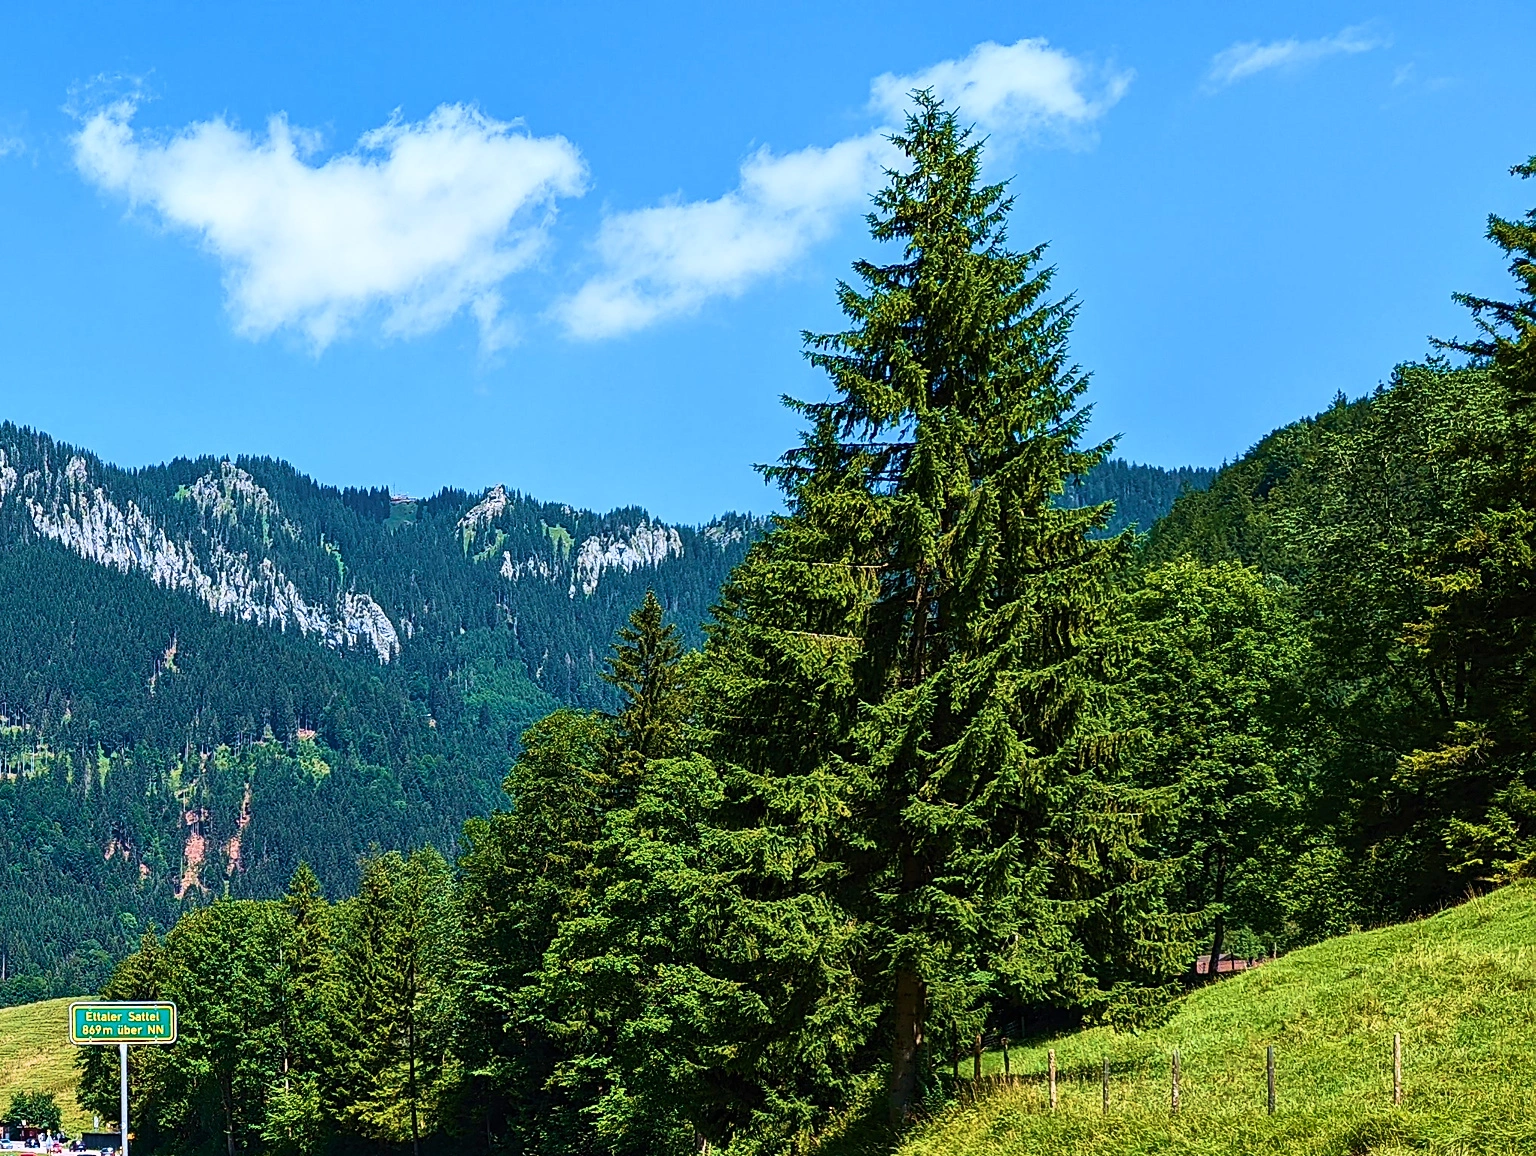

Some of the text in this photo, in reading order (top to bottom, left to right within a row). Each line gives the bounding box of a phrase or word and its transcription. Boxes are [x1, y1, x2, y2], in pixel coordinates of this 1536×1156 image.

[85, 1011, 160, 1022] Ettaler Sattel
[117, 1024, 142, 1035] über
[147, 1025, 165, 1035] NN
